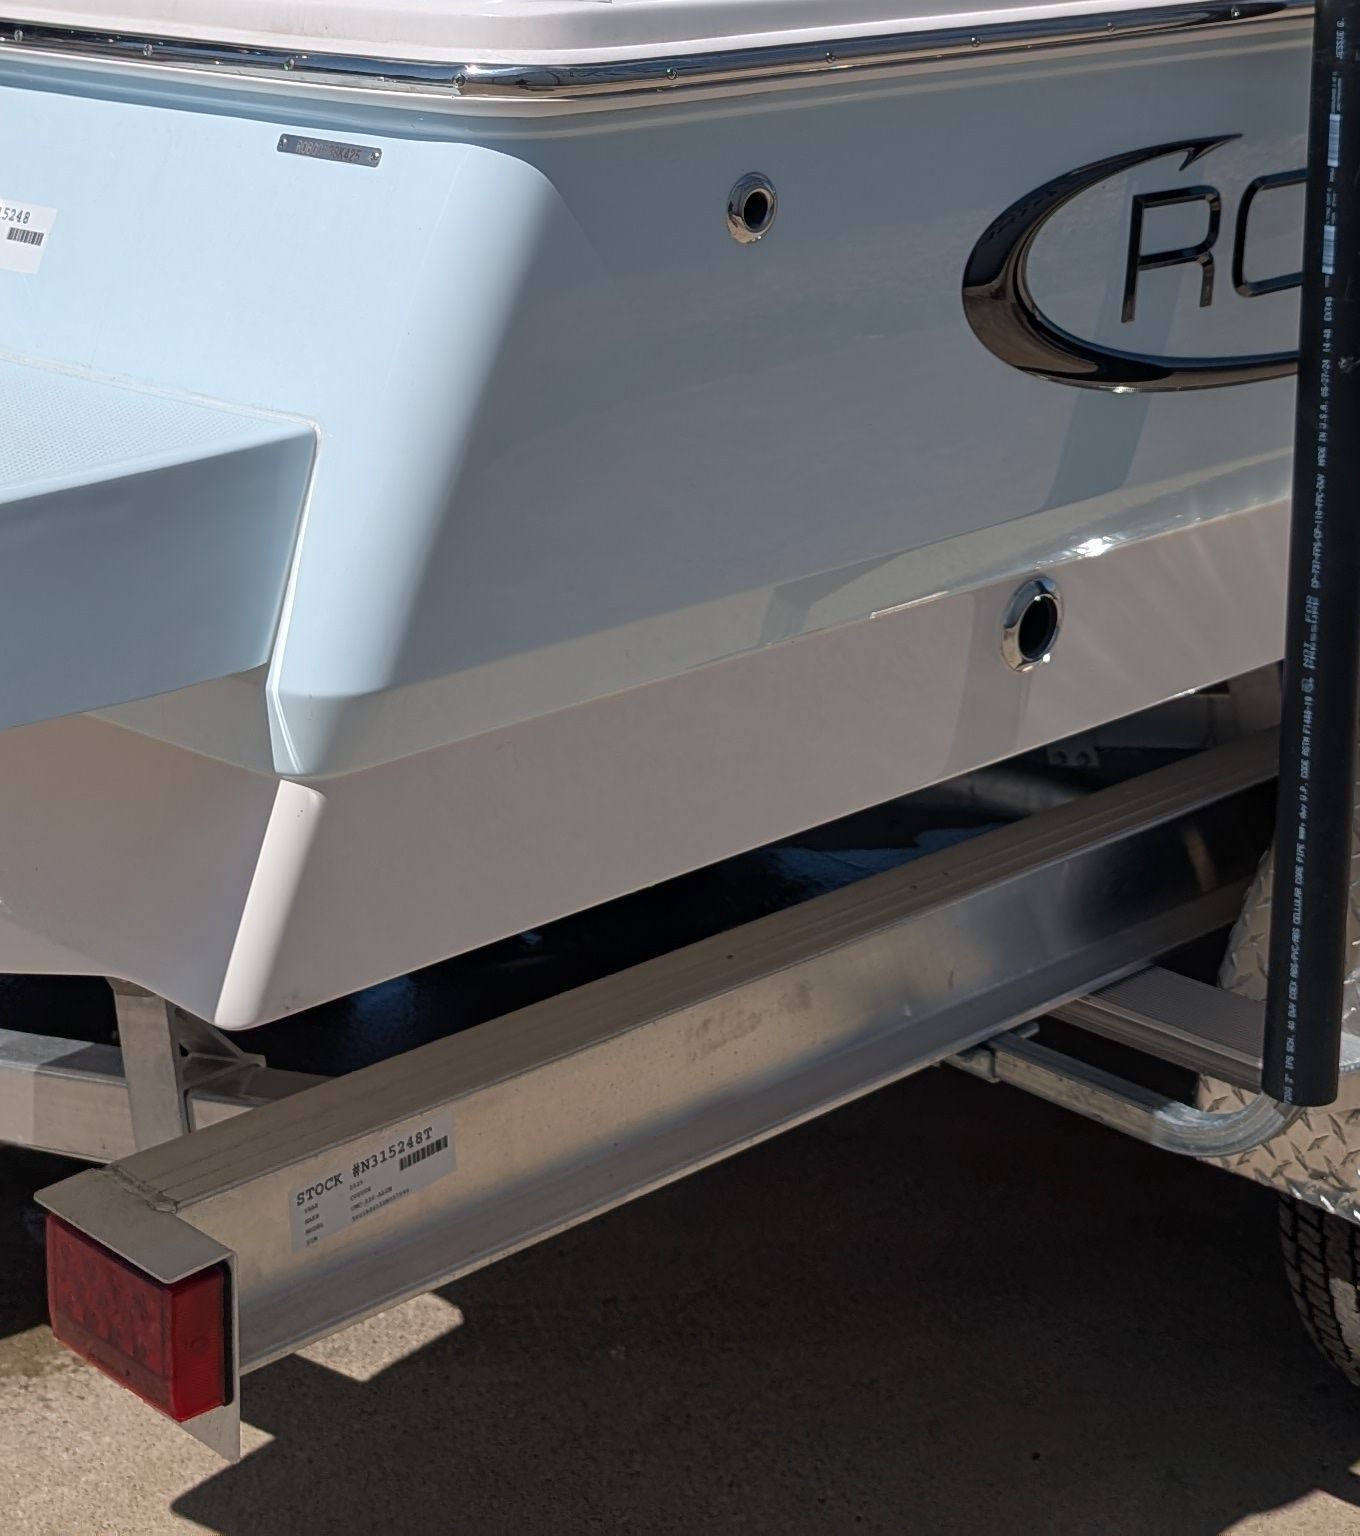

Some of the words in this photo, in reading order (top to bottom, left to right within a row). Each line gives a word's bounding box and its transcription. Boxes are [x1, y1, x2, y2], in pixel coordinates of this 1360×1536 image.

[1318, 432, 1327, 442] IN
[1317, 446, 1327, 467] MADE
[1301, 736, 1311, 757] ASTM
[1300, 759, 1309, 779] CODE
[1296, 842, 1306, 863] PIPE
[1294, 866, 1304, 884] CORE
[1293, 887, 1303, 925] CELLULAR
[1288, 980, 1298, 1000] COEX
[1287, 1020, 1295, 1031] 40
[1285, 1056, 1294, 1070] IPS
[296, 1172, 343, 1207] STOCK
[351, 1126, 433, 1178] #N315248T
